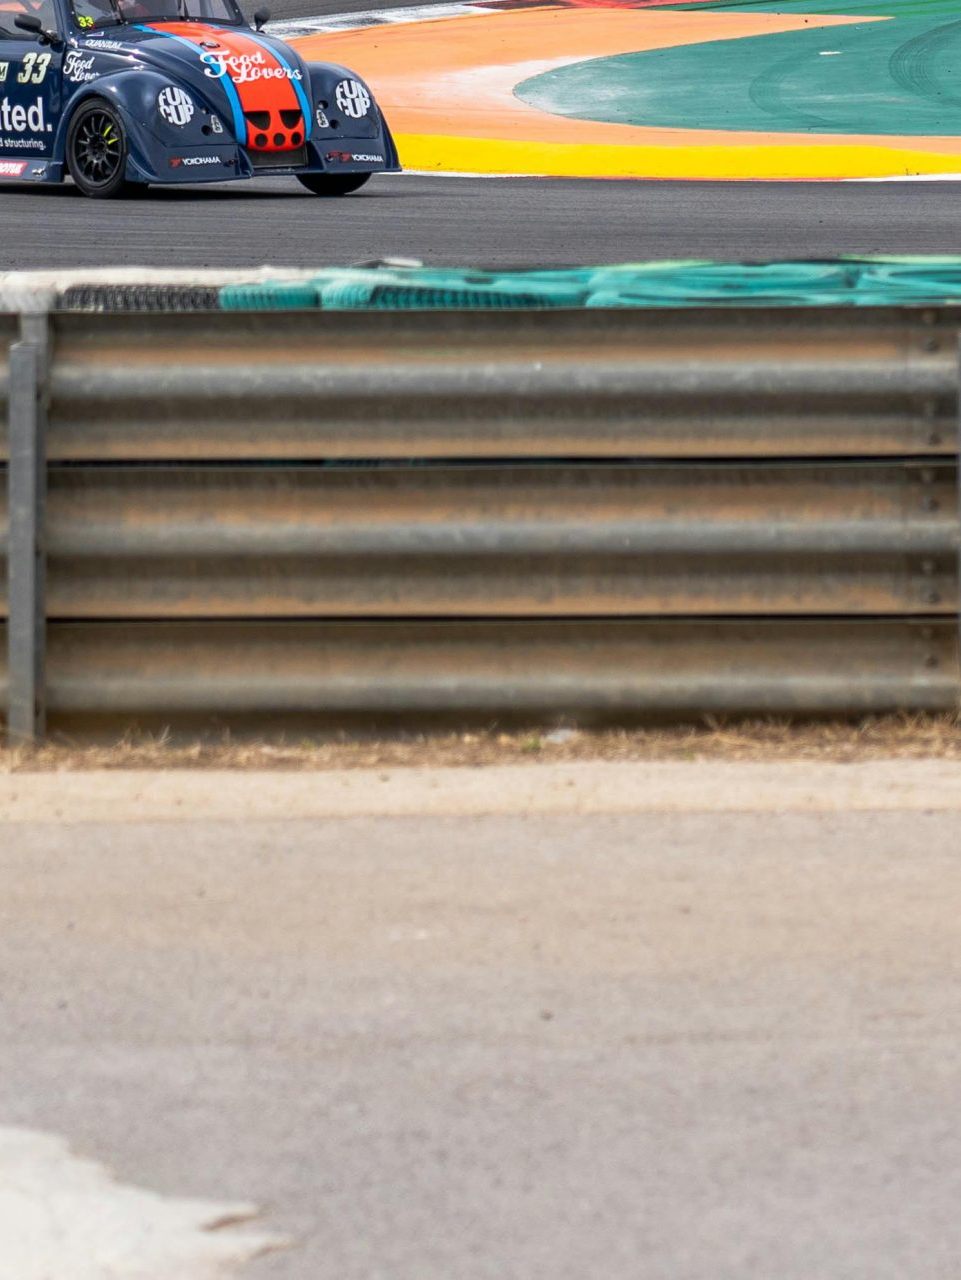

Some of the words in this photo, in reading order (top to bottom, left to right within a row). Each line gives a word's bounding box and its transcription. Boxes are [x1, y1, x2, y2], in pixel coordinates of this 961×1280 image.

[78, 16, 94, 27] 33
[17, 52, 52, 84] 33
[63, 51, 95, 75] Food
[199, 49, 265, 79] Food
[232, 64, 303, 84] Lovers
[158, 86, 192, 106] FUN
[335, 79, 369, 100] FUN
[159, 103, 194, 126] CUP
[336, 96, 371, 118] CUP
[181, 156, 221, 166] YOKOHAMA
[350, 153, 384, 163] YOKOHAMA
